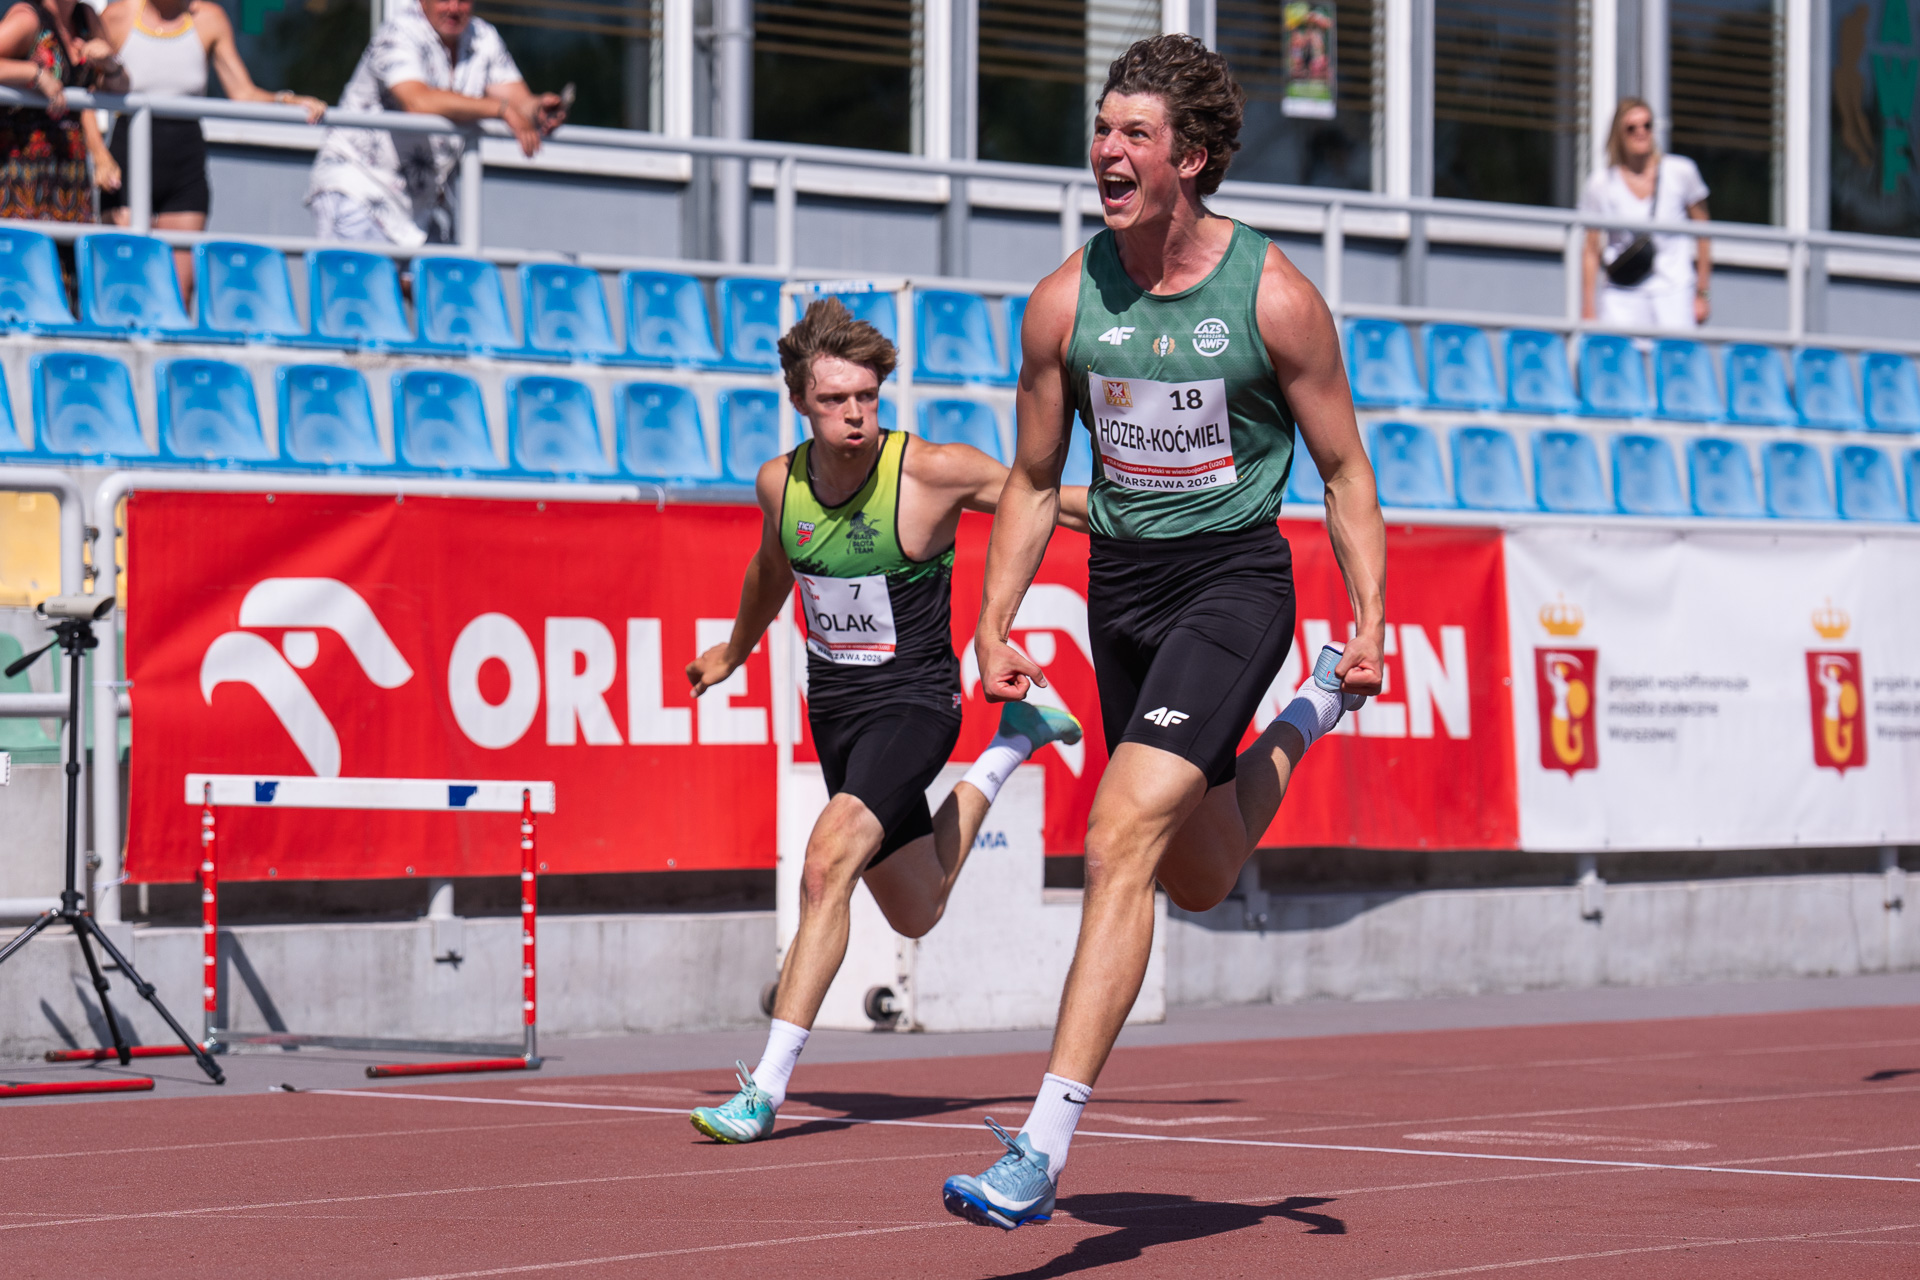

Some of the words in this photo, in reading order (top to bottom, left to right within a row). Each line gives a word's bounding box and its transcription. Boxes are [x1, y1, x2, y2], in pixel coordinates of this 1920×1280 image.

[1098, 327, 1136, 345] 4F
[1201, 324, 1222, 333] AZS
[1198, 339, 1224, 349] AWF
[1169, 388, 1203, 411] 18
[1098, 417, 1225, 453] HOZER-KOĆMIEL
[1172, 465, 1208, 475] wielobojach
[1115, 472, 1185, 489] WARSZAWA
[1187, 474, 1217, 488] 2026
[849, 584, 861, 600] 7
[1252, 617, 1472, 740] RLEN
[1143, 706, 1190, 728] 4F
[973, 832, 1008, 849] MA
